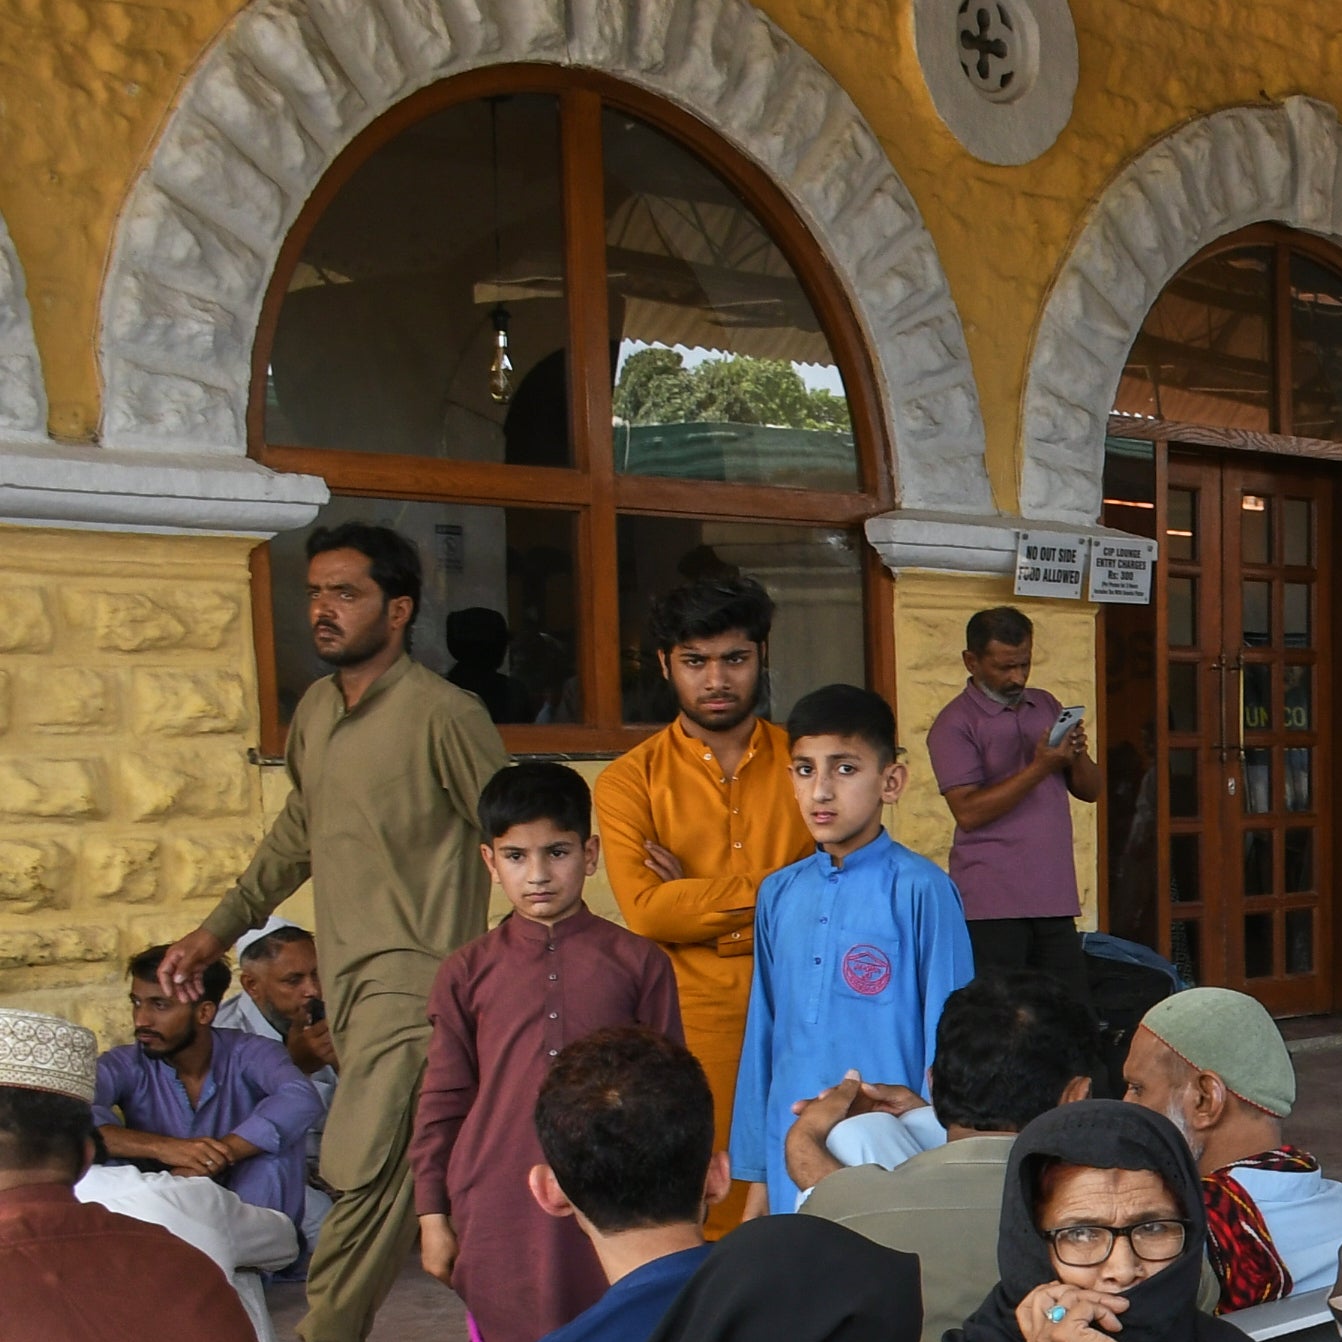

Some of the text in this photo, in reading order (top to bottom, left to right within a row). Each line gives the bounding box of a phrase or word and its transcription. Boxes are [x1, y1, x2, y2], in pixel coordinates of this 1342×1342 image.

[1026, 546, 1077, 563] NO OUT SIDE
[1019, 566, 1079, 584] FOOD ALLOWED
